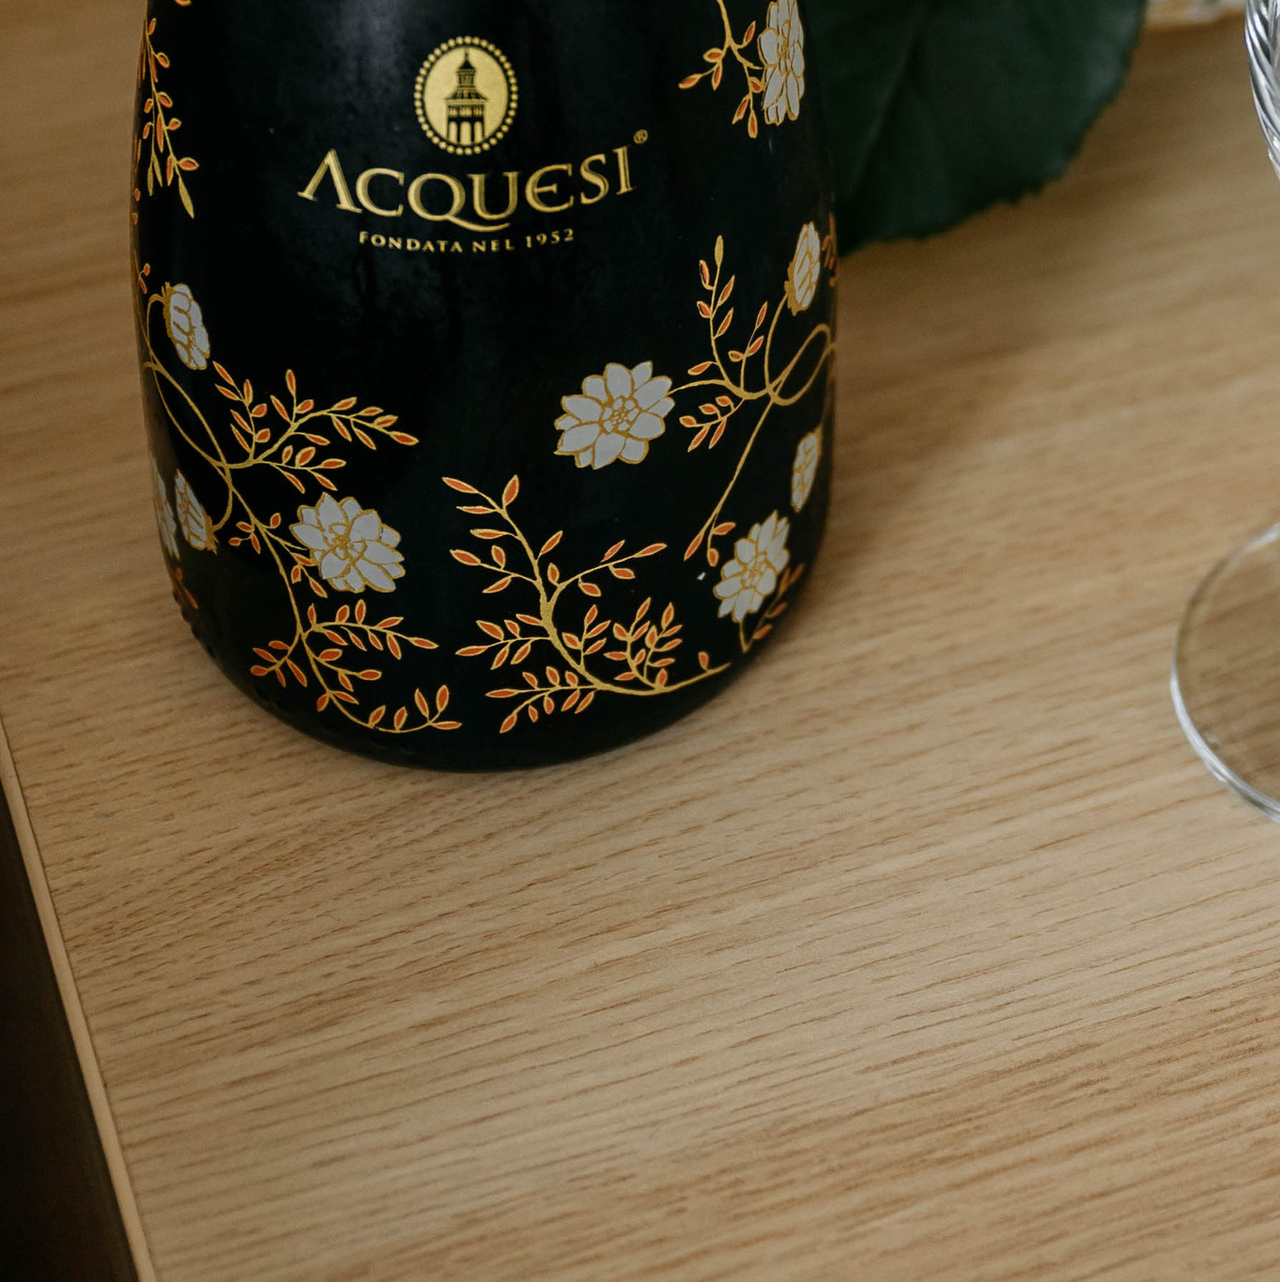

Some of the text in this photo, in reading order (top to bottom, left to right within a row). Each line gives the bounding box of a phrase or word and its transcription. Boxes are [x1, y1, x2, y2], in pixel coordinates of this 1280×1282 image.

[358, 228, 575, 254] FONDATA NEL 1952
